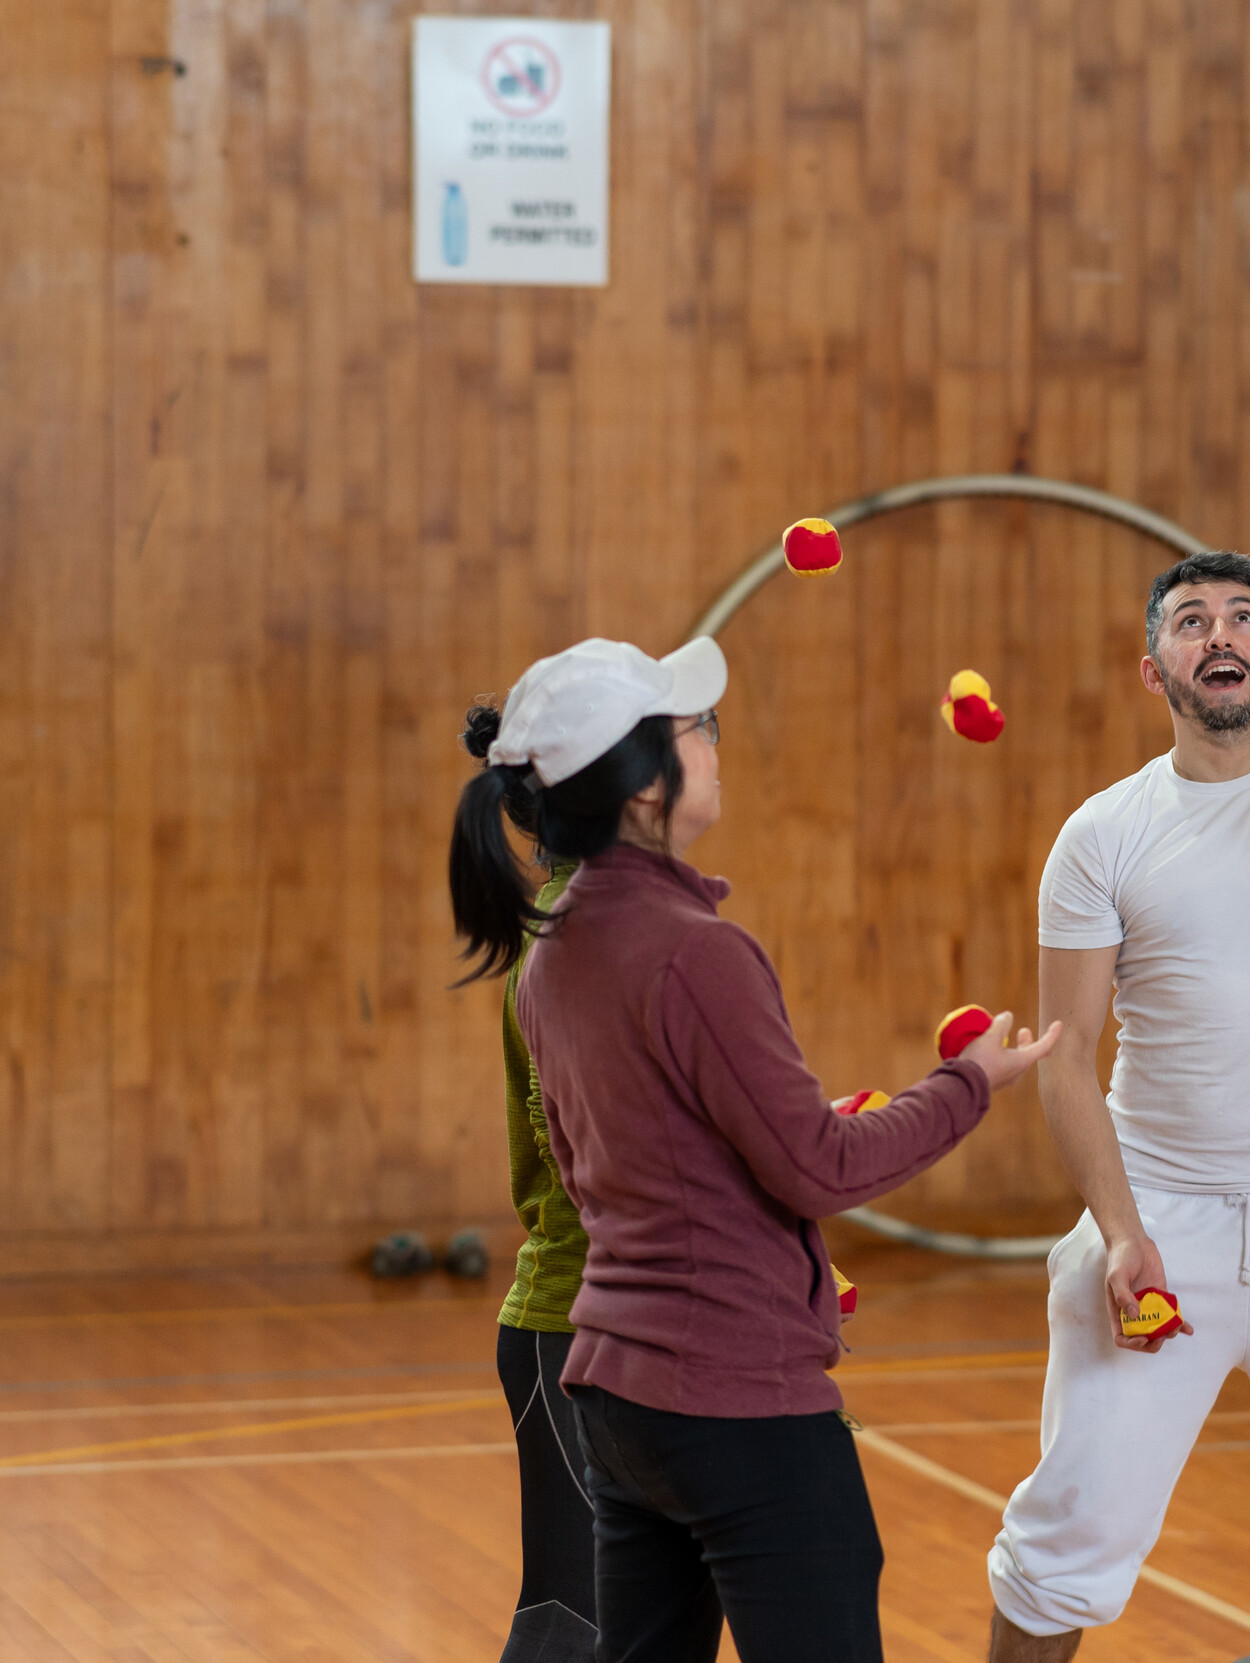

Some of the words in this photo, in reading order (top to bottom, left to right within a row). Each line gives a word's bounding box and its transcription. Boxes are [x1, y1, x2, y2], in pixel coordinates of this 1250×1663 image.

[470, 119, 499, 135] NO
[470, 142, 499, 158] OR
[512, 201, 575, 218] WATER
[491, 226, 597, 246] PERMITTED
